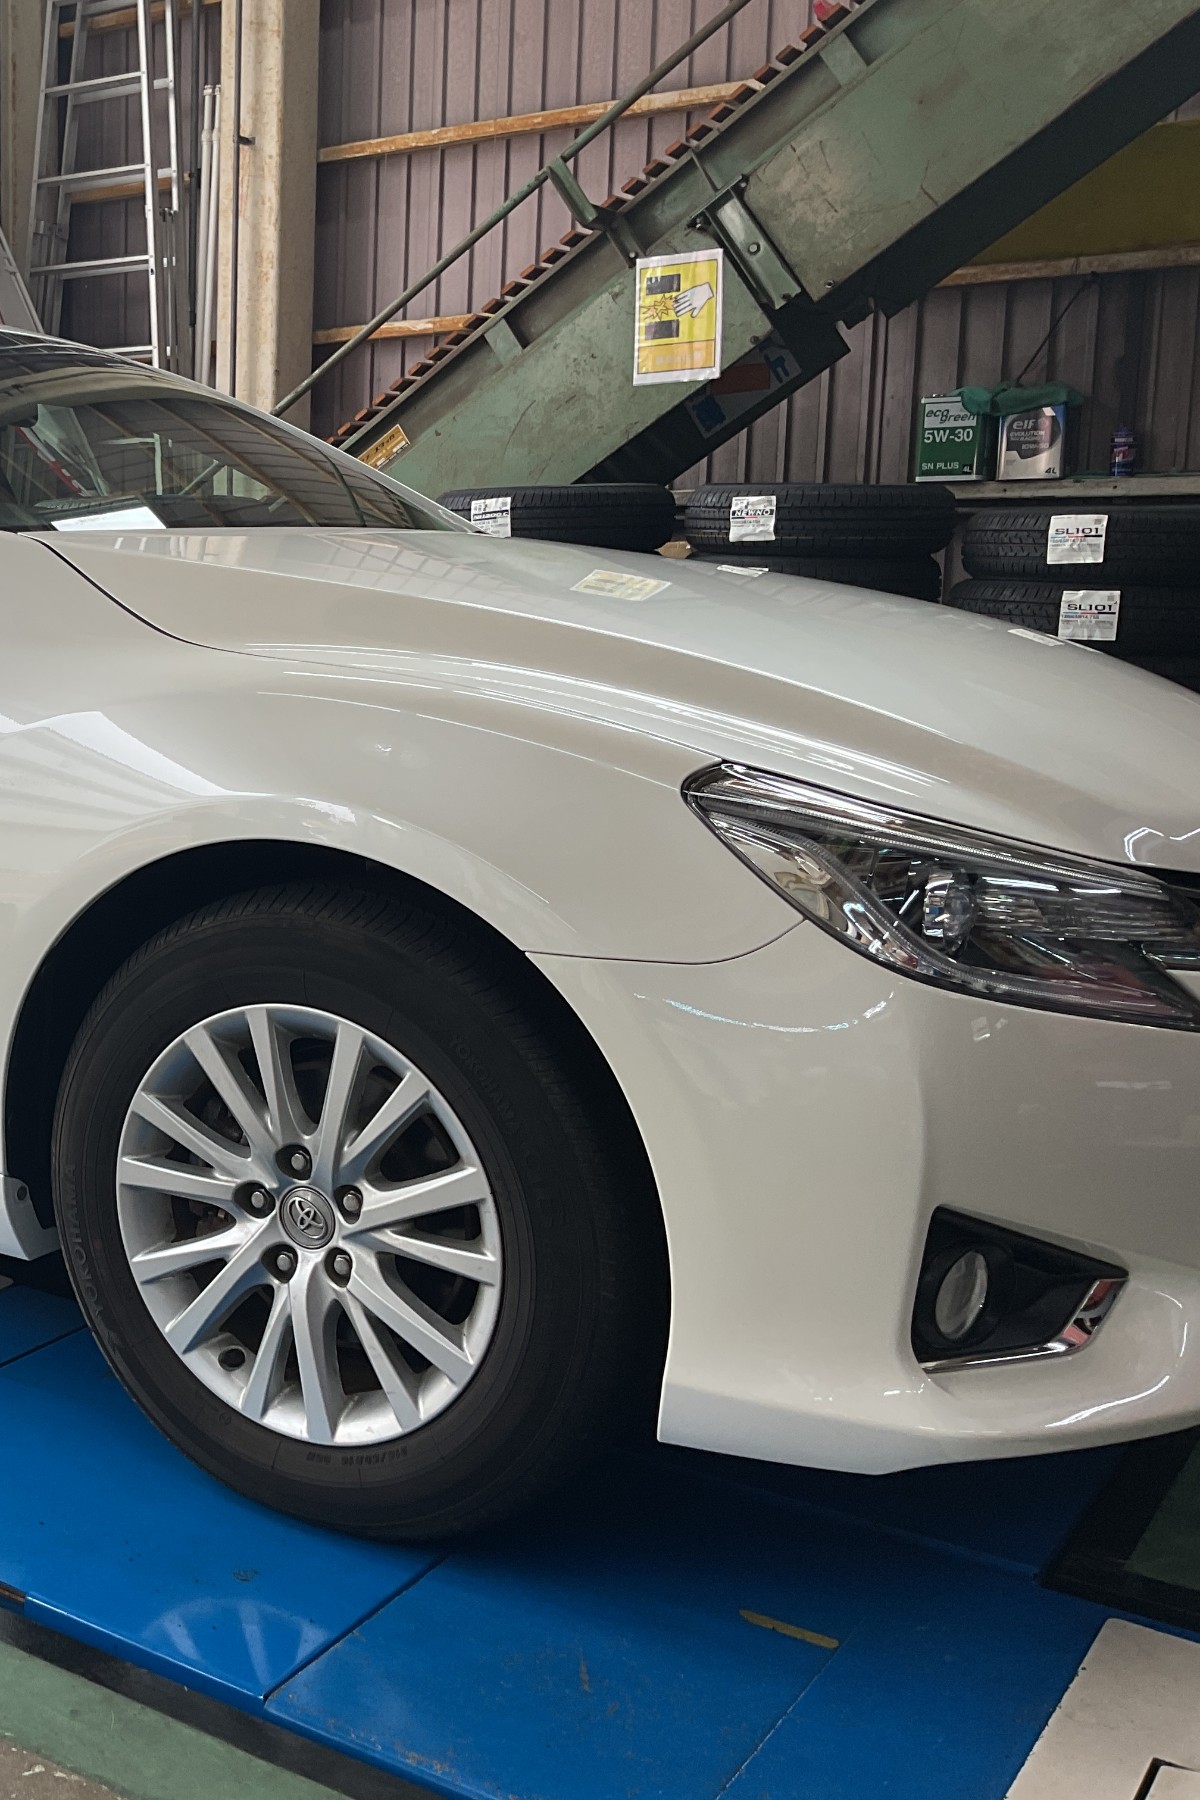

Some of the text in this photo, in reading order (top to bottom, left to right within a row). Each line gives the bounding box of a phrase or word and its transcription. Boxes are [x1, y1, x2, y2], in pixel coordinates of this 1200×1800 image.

[926, 409, 950, 418] eco
[939, 413, 977, 424] green
[1012, 419, 1036, 430] elf
[924, 428, 973, 443] 5W-30
[921, 461, 959, 470] SN PLUS
[962, 465, 972, 473] 4L
[1044, 466, 1057, 474] 4L
[1054, 527, 1100, 535] SL101
[1067, 603, 1113, 611] SL101
[64, 1166, 105, 1318] YOKOHAMA
